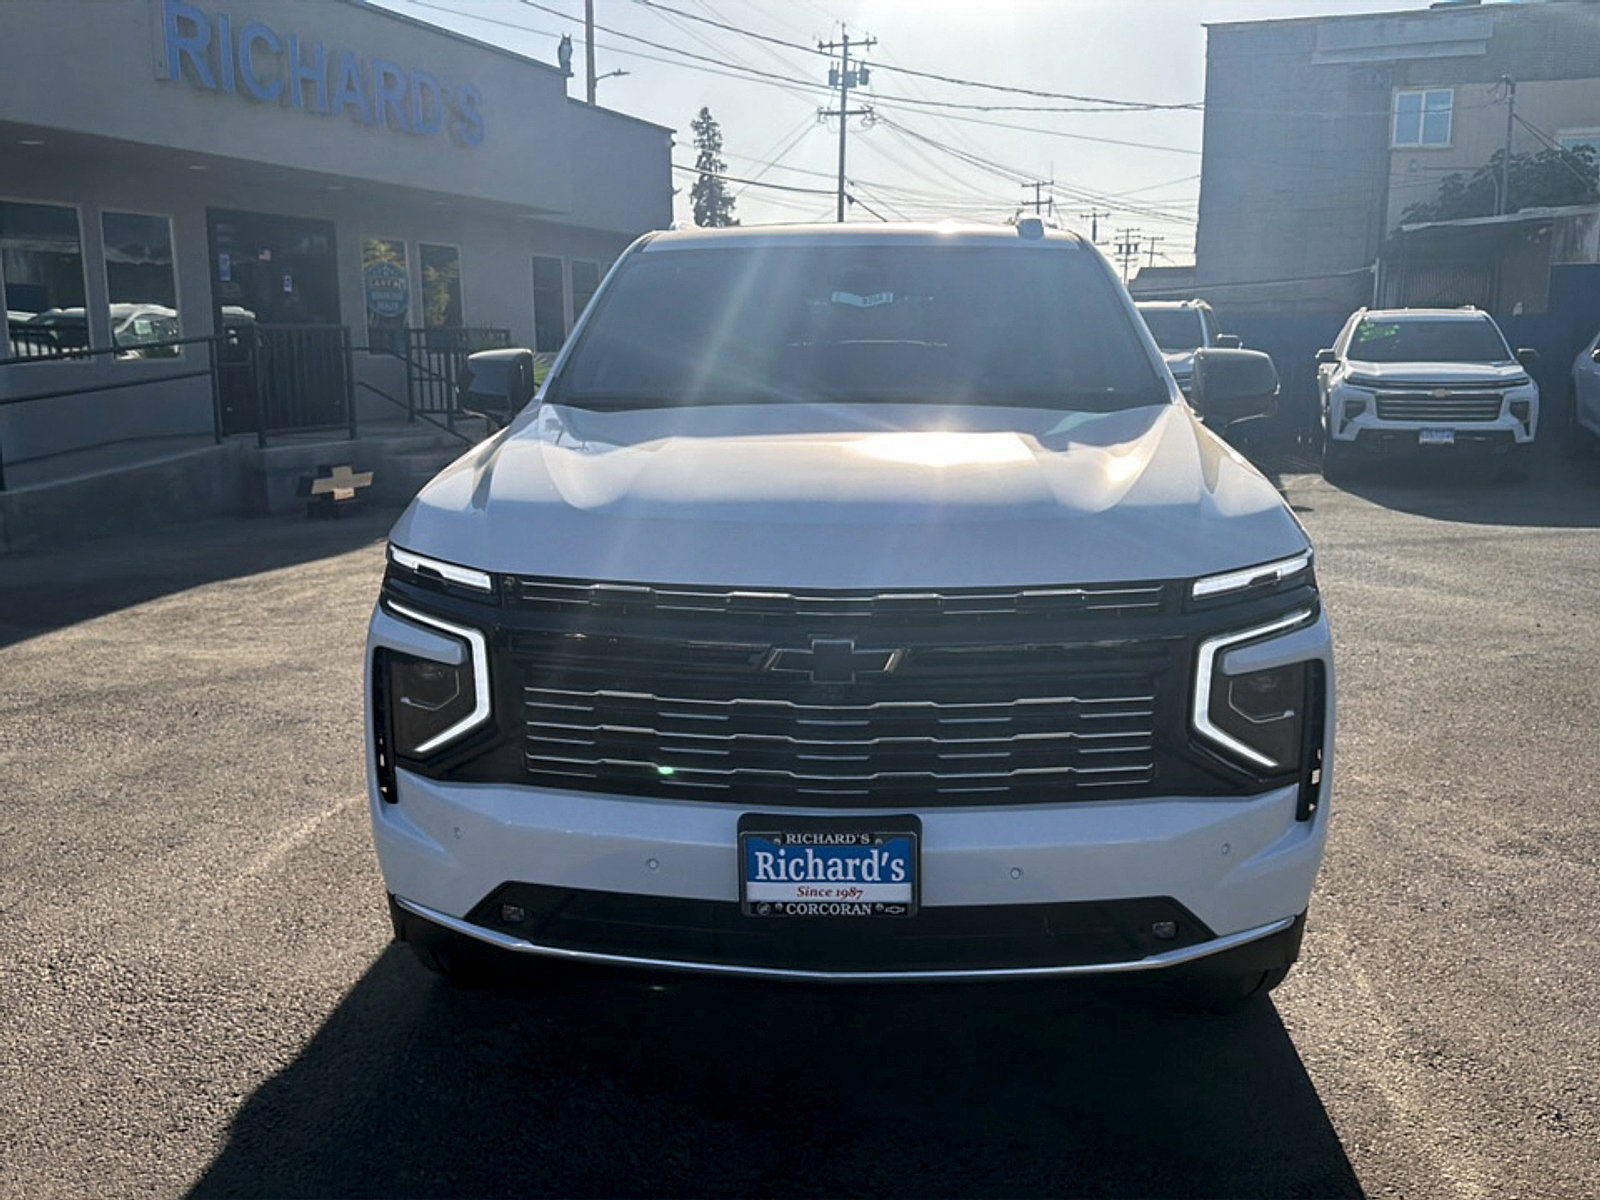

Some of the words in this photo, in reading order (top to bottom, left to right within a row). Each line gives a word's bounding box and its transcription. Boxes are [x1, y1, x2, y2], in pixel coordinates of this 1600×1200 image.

[160, 0, 485, 146] RICHARD'S
[786, 833, 871, 845] RICHARD'S
[755, 849, 905, 882] Richard's
[797, 886, 833, 898] Since
[836, 886, 864, 900] 1987
[786, 903, 872, 915] CORCORAN
